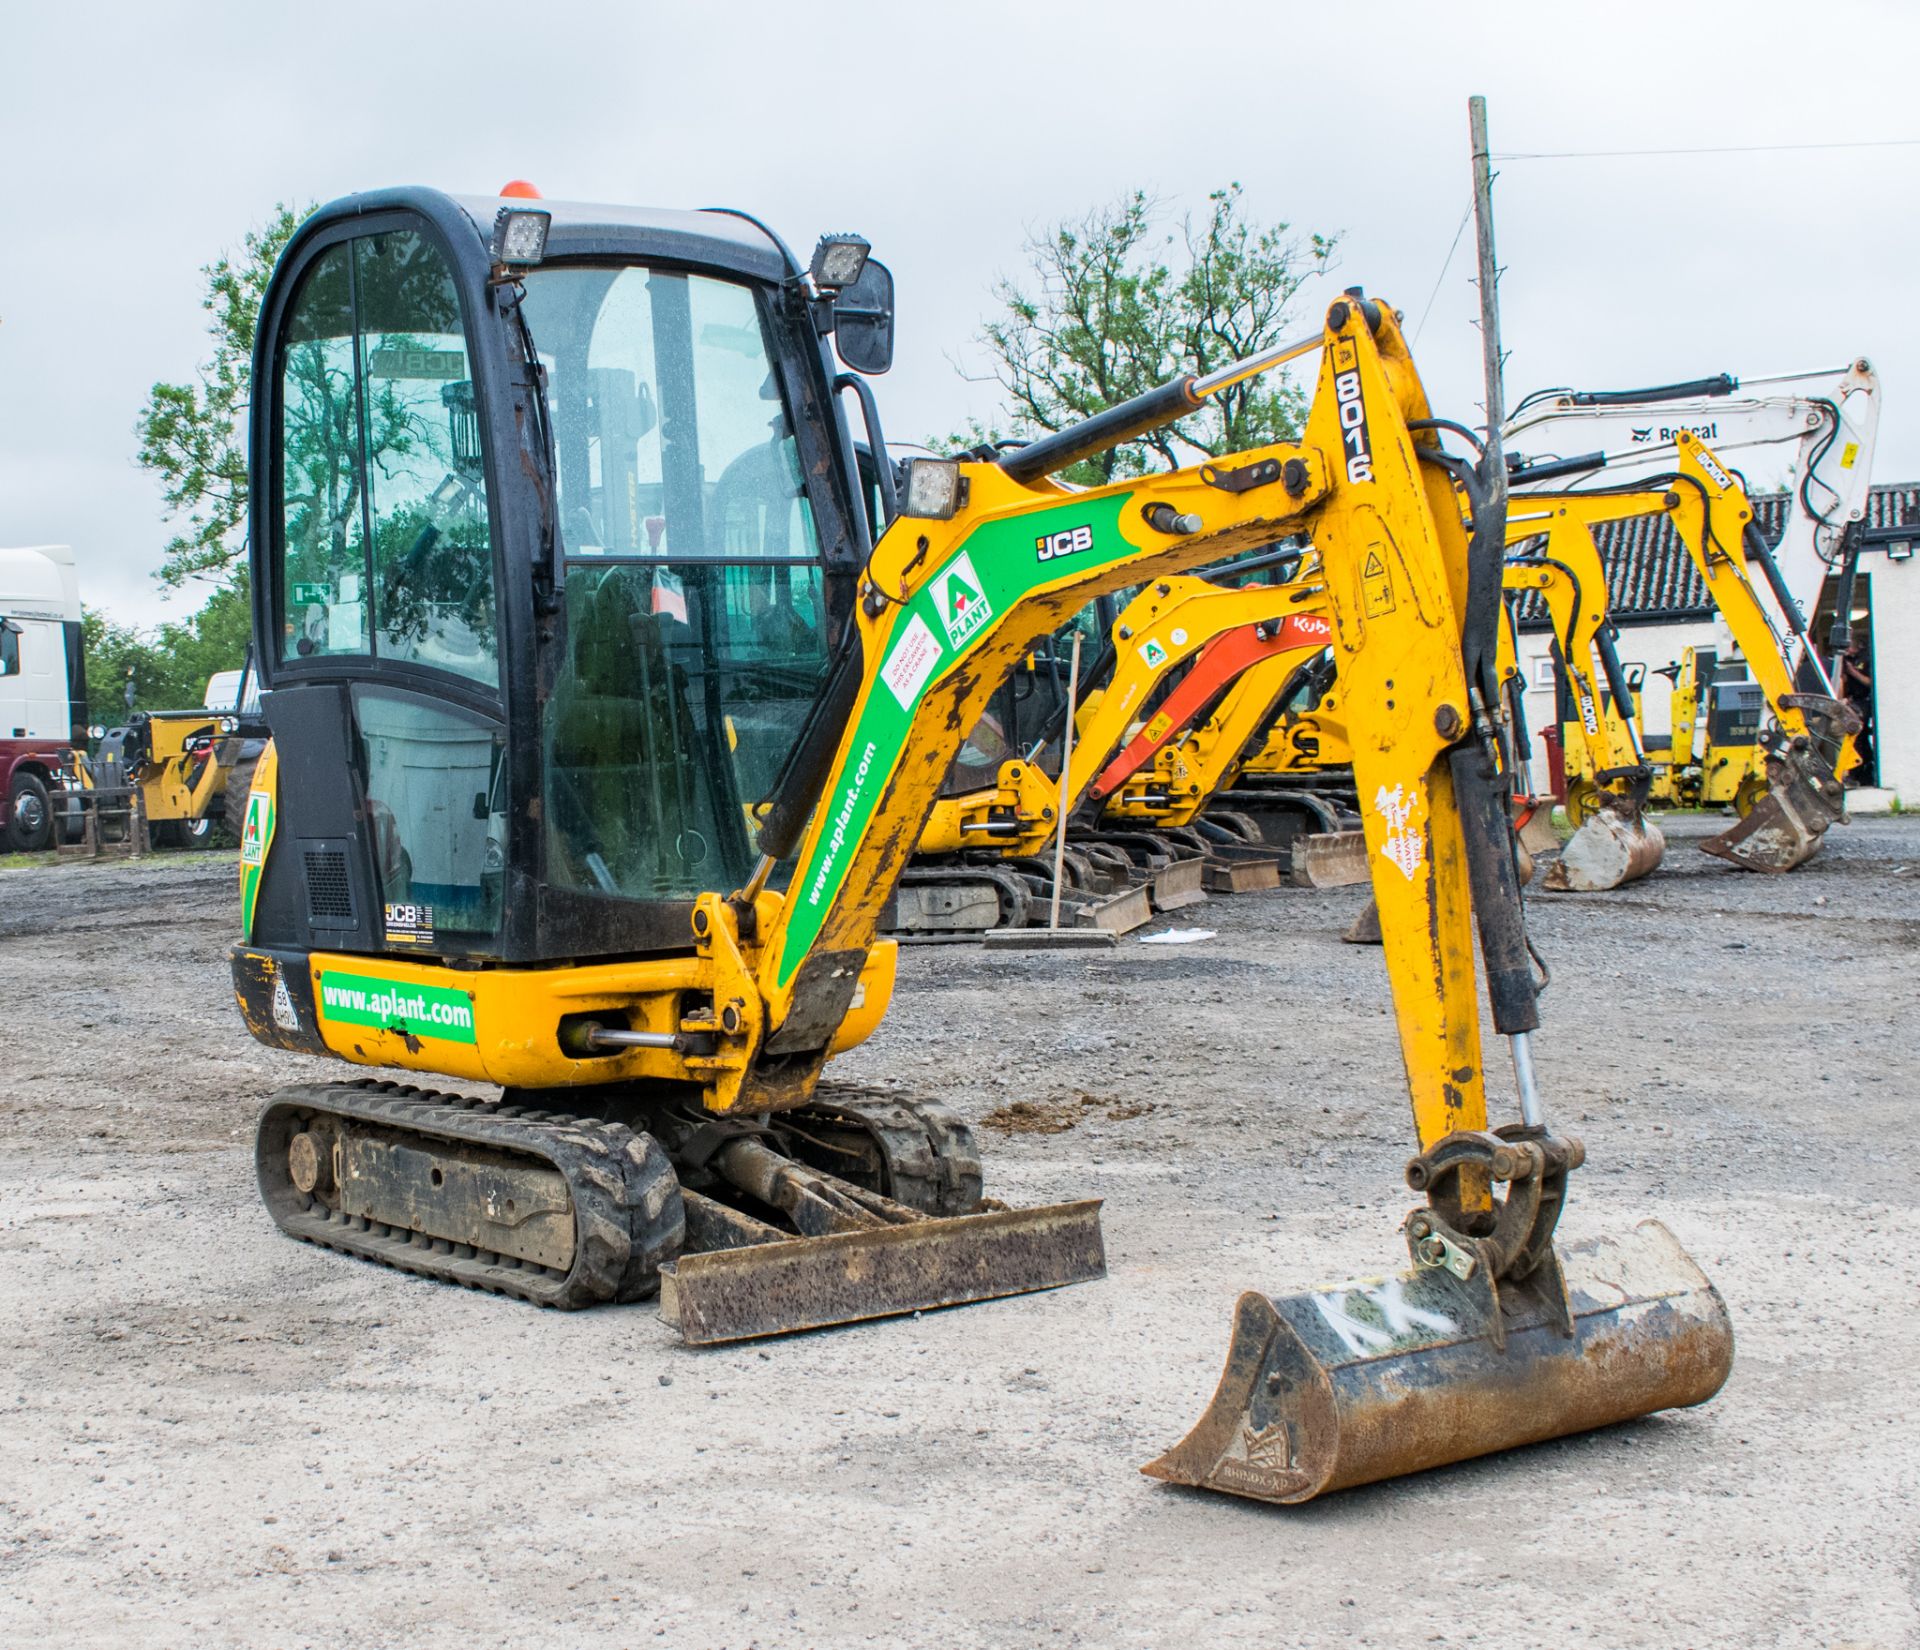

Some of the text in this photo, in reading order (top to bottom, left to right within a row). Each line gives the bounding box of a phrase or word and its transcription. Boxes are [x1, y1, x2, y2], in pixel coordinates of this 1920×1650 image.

[1336, 371, 1373, 484] 8016
[1037, 526, 1093, 561] JCB
[947, 573, 979, 623] A
[949, 601, 988, 645] PLANT
[892, 633, 919, 676] DO NOT USE
[892, 632, 928, 689] THIS EXCAVATOR
[809, 742, 877, 906] www.aplant.com
[385, 904, 416, 922] JCB
[277, 991, 288, 1007] 58
[323, 985, 471, 1028] www.aplant.com
